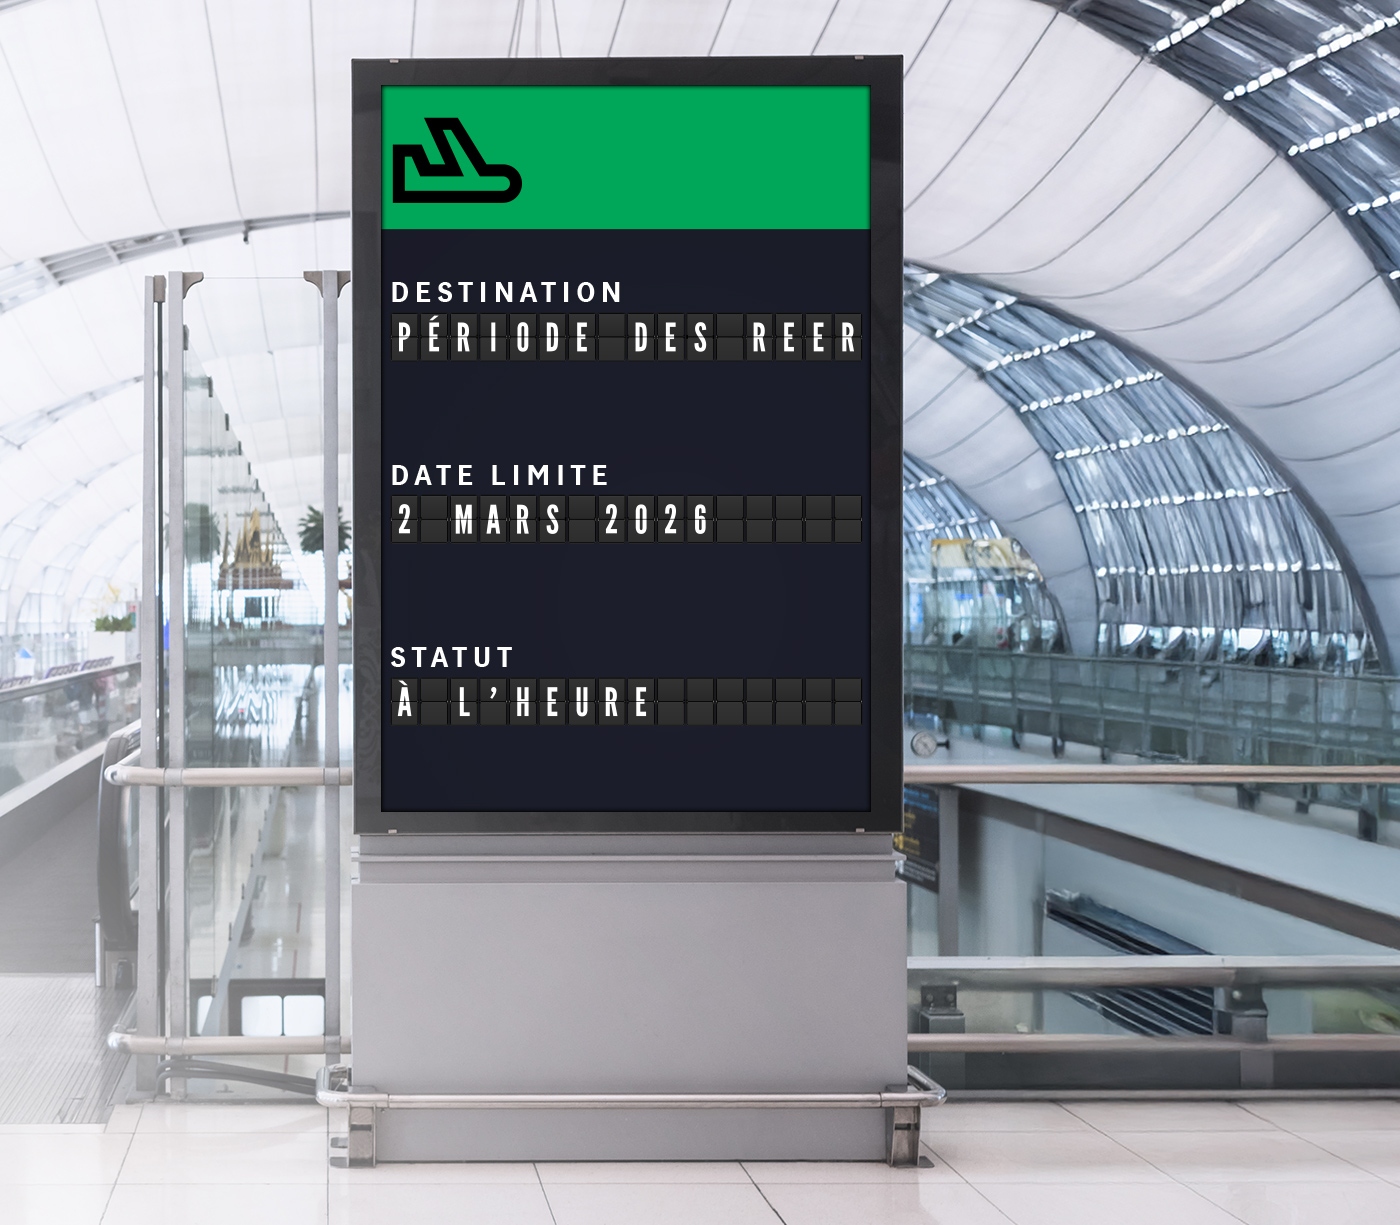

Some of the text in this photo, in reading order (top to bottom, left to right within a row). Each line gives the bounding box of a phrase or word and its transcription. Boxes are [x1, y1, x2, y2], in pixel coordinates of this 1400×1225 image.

[391, 281, 621, 303] DESTINATION
[398, 314, 856, 353] PÉRIODE DES REER
[391, 464, 609, 486] DATE LIMITE
[398, 503, 707, 535] 2 MARS 2026
[390, 646, 514, 668] STATUT
[397, 679, 648, 718] À L’HEURE
